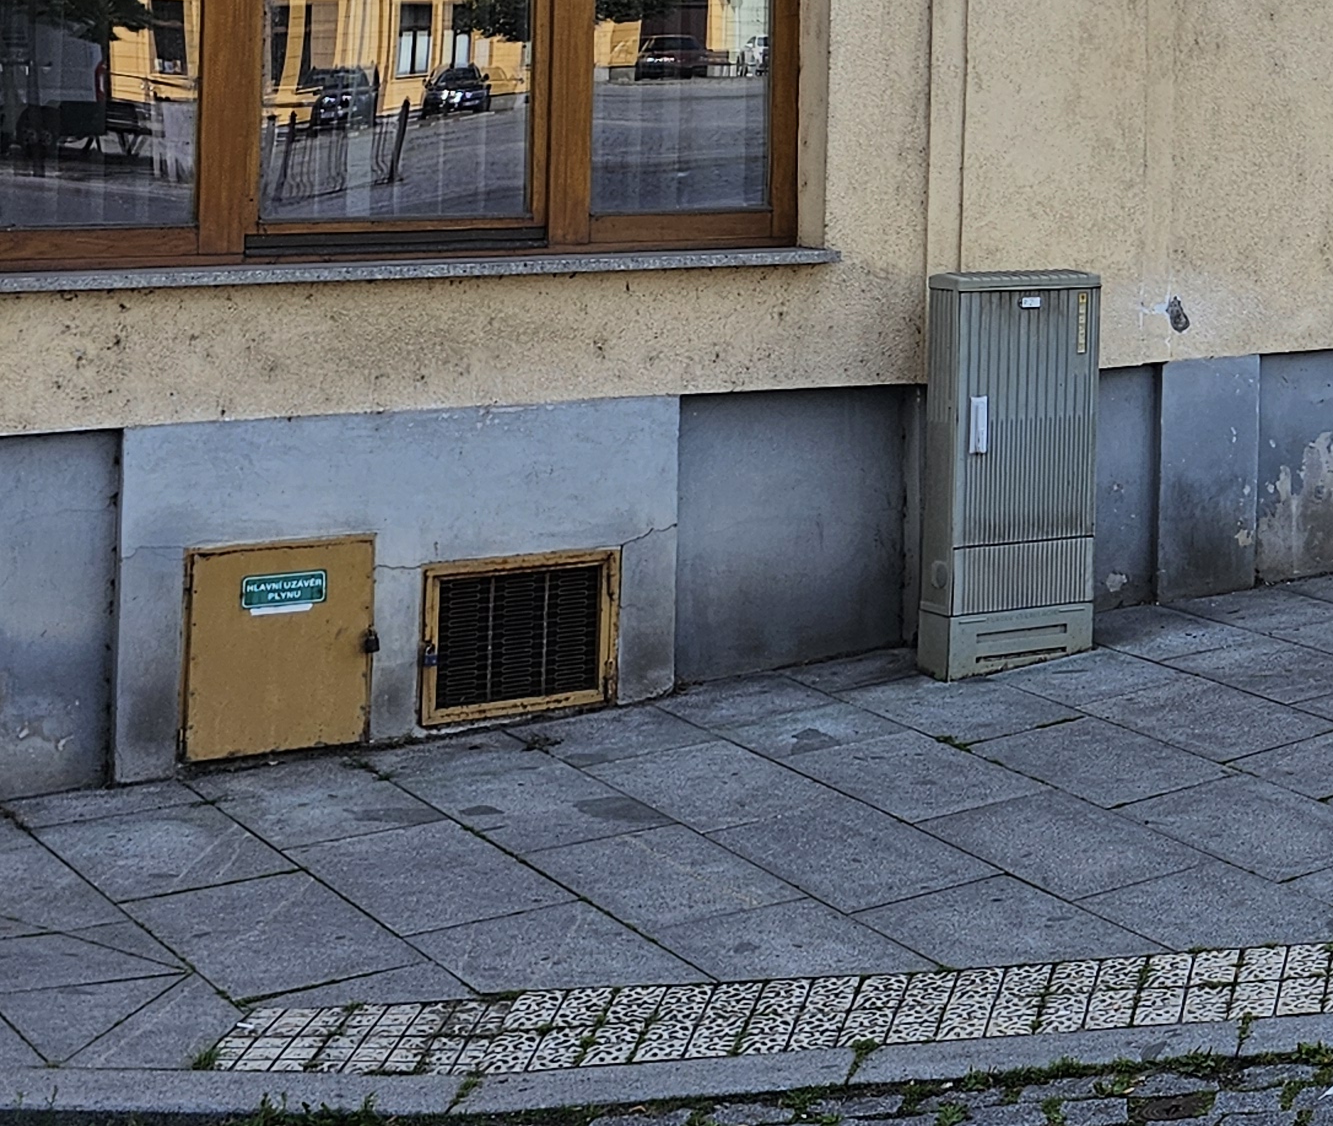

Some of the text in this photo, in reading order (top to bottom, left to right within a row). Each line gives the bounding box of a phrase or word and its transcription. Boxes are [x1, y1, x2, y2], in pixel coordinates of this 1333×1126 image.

[247, 577, 322, 592] HLAVNÍ UZÁVĚR
[267, 591, 301, 600] PLYNU
